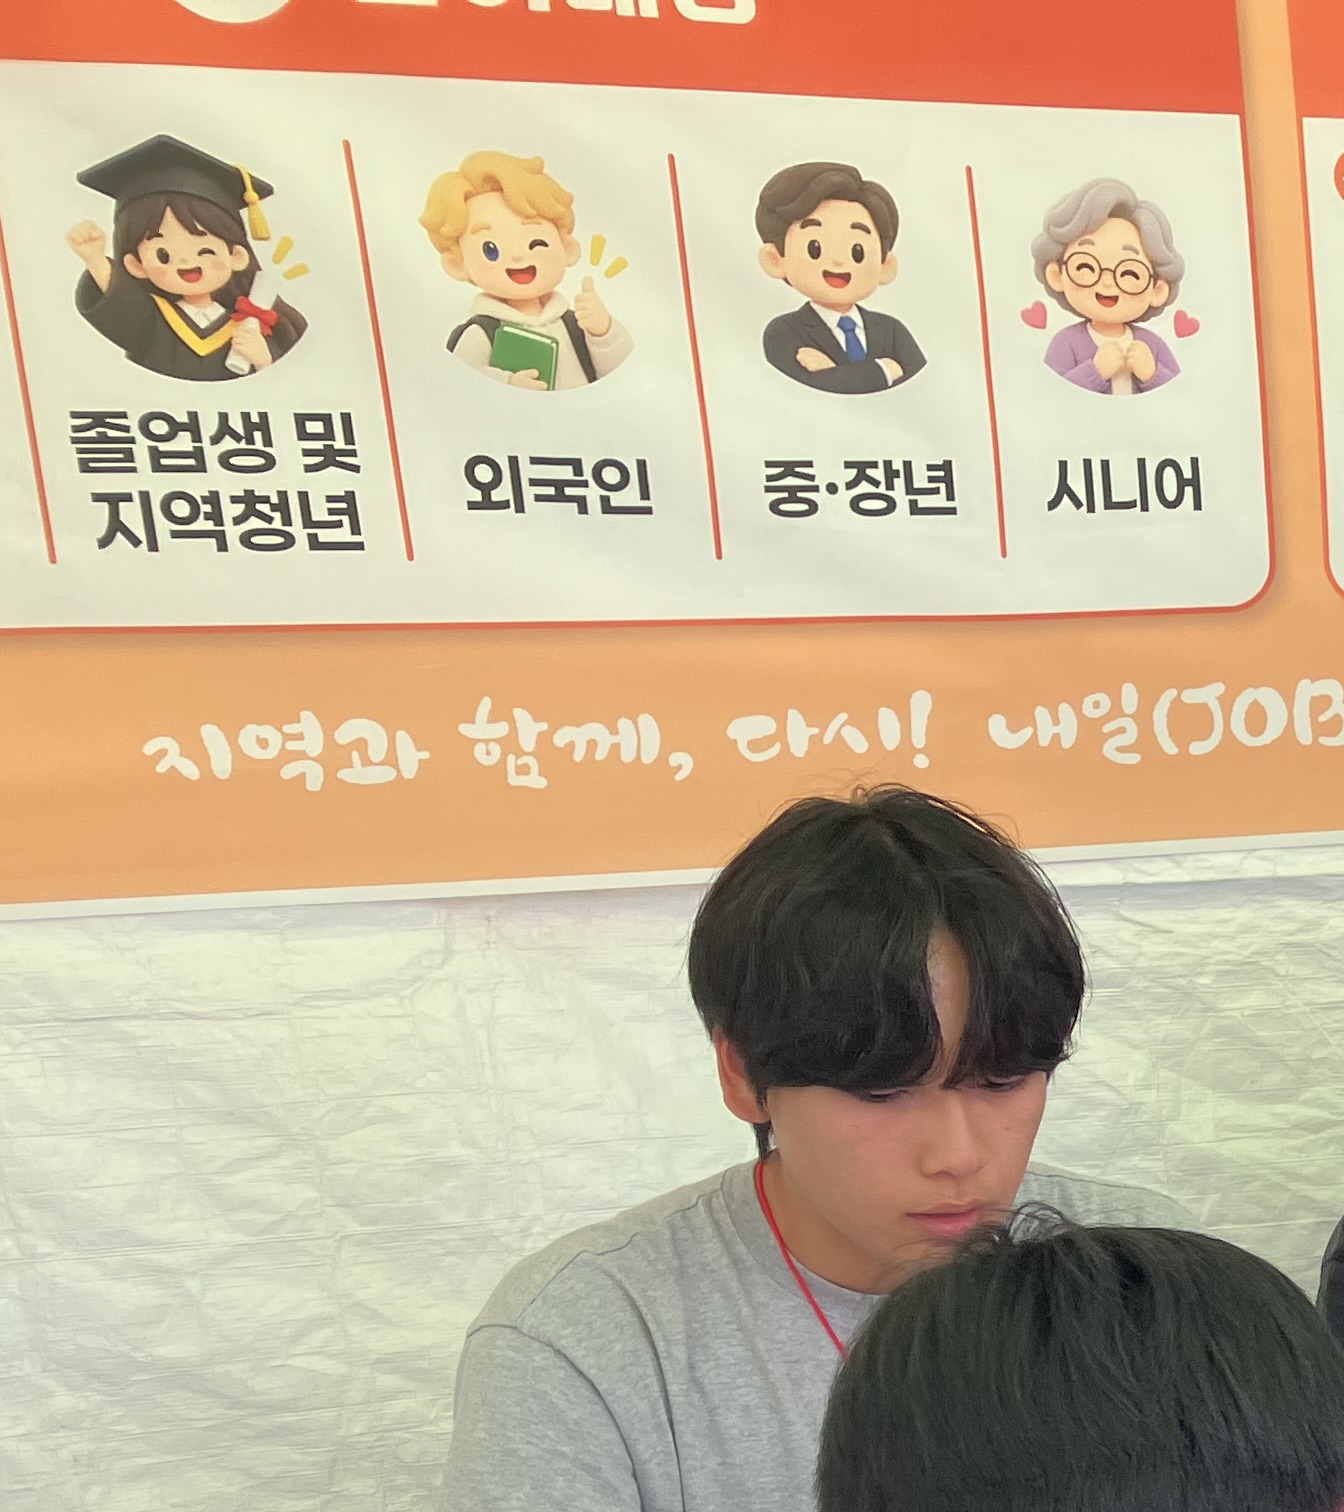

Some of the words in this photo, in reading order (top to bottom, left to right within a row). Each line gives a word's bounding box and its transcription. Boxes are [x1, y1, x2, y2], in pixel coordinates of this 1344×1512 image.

[70, 411, 277, 474] 졸업생
[293, 412, 361, 474] 및
[464, 455, 653, 516] 외국인
[764, 459, 958, 518] 중·장년
[1047, 456, 1202, 514] 시니어
[91, 489, 365, 553] 지역청년
[143, 710, 430, 791] 지역과
[458, 696, 694, 789] 함께,
[726, 690, 932, 769] 다시!
